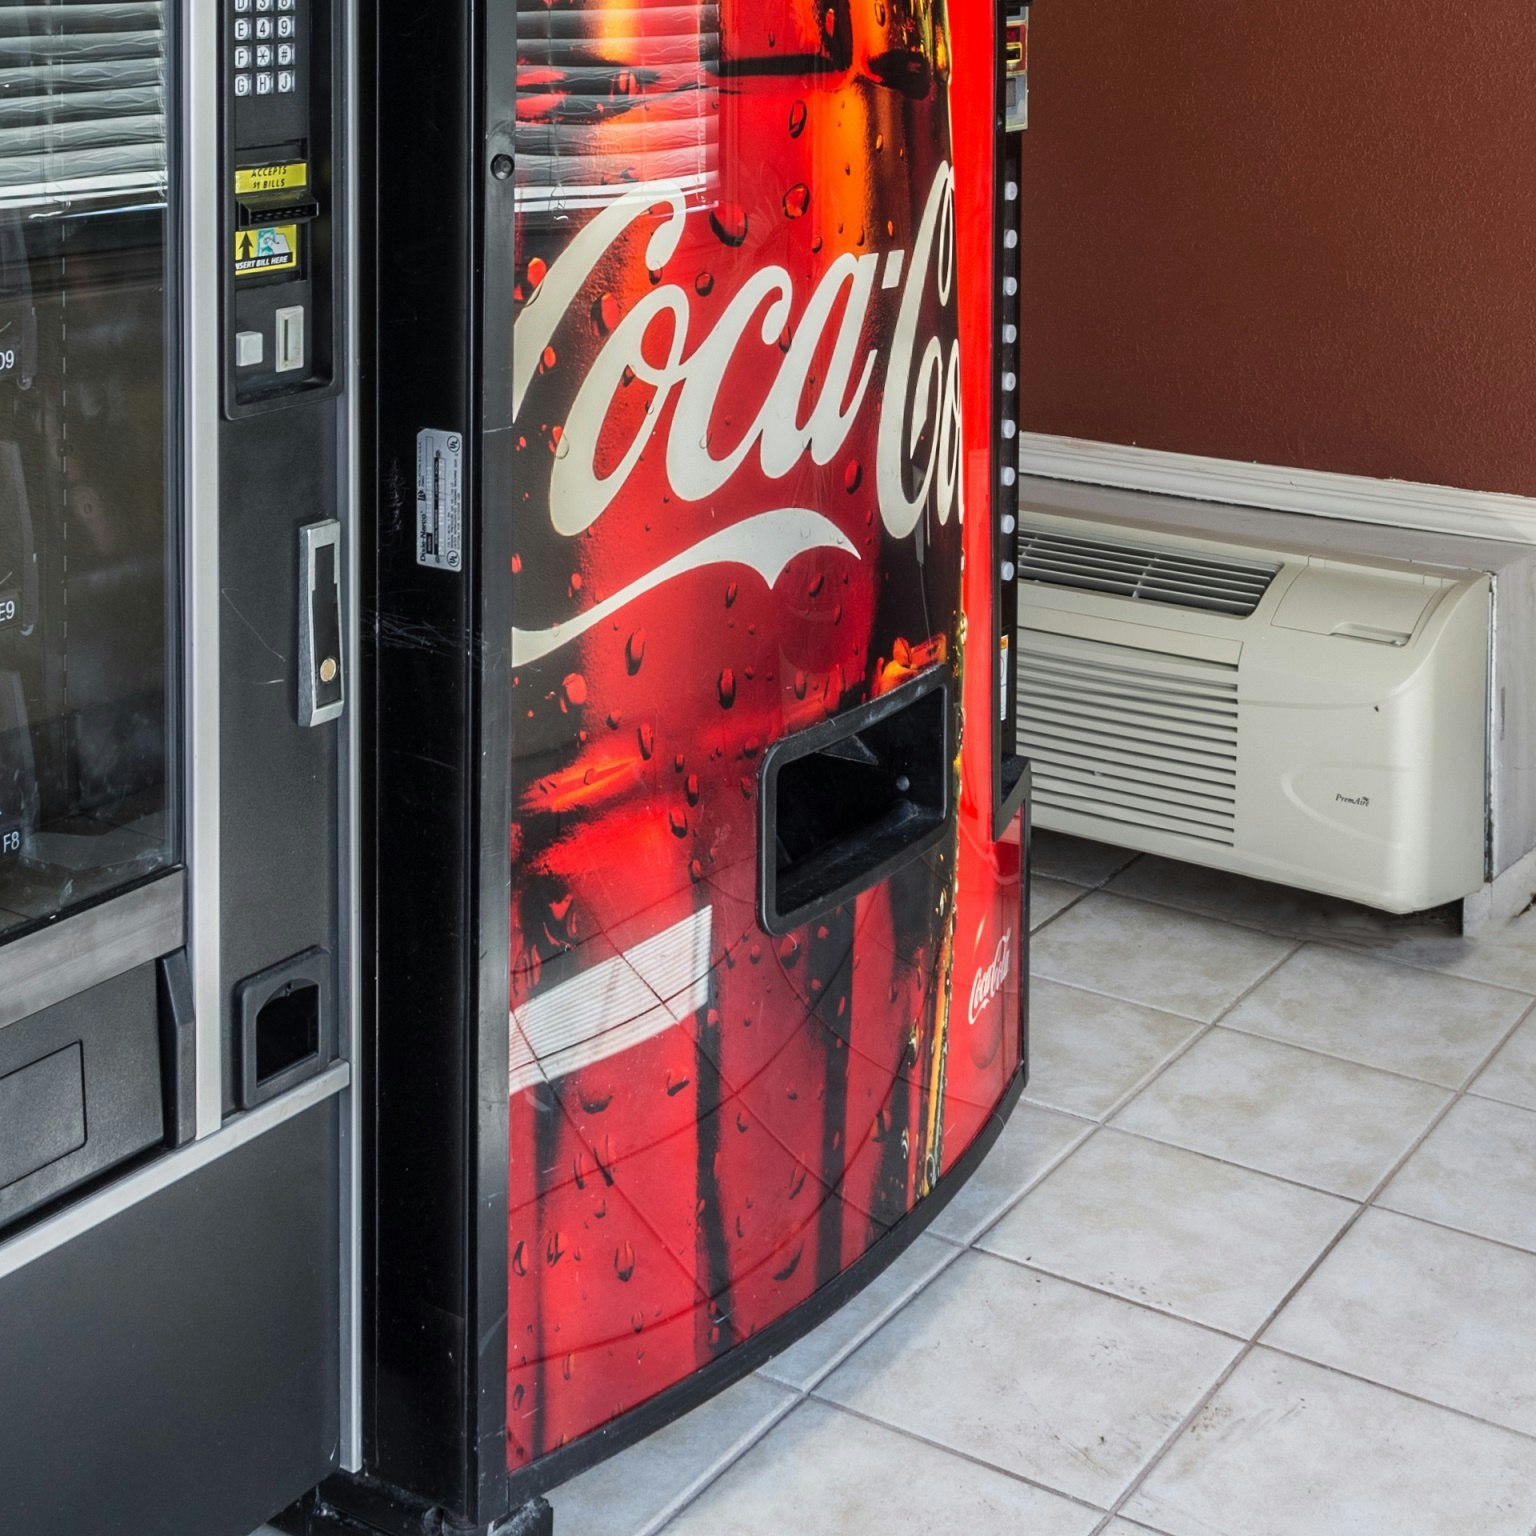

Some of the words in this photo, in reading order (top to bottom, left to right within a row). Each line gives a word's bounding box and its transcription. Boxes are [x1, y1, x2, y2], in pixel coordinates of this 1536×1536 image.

[251, 165, 287, 178] ACCEPTS
[262, 178, 285, 189] BILLS
[235, 258, 255, 270] NSERT
[256, 257, 270, 267] BILL
[271, 255, 288, 265] HERE
[1335, 792, 1371, 809] PremAire
[3, 831, 20, 855] F8
[968, 927, 1011, 1025] Coca-Cola
